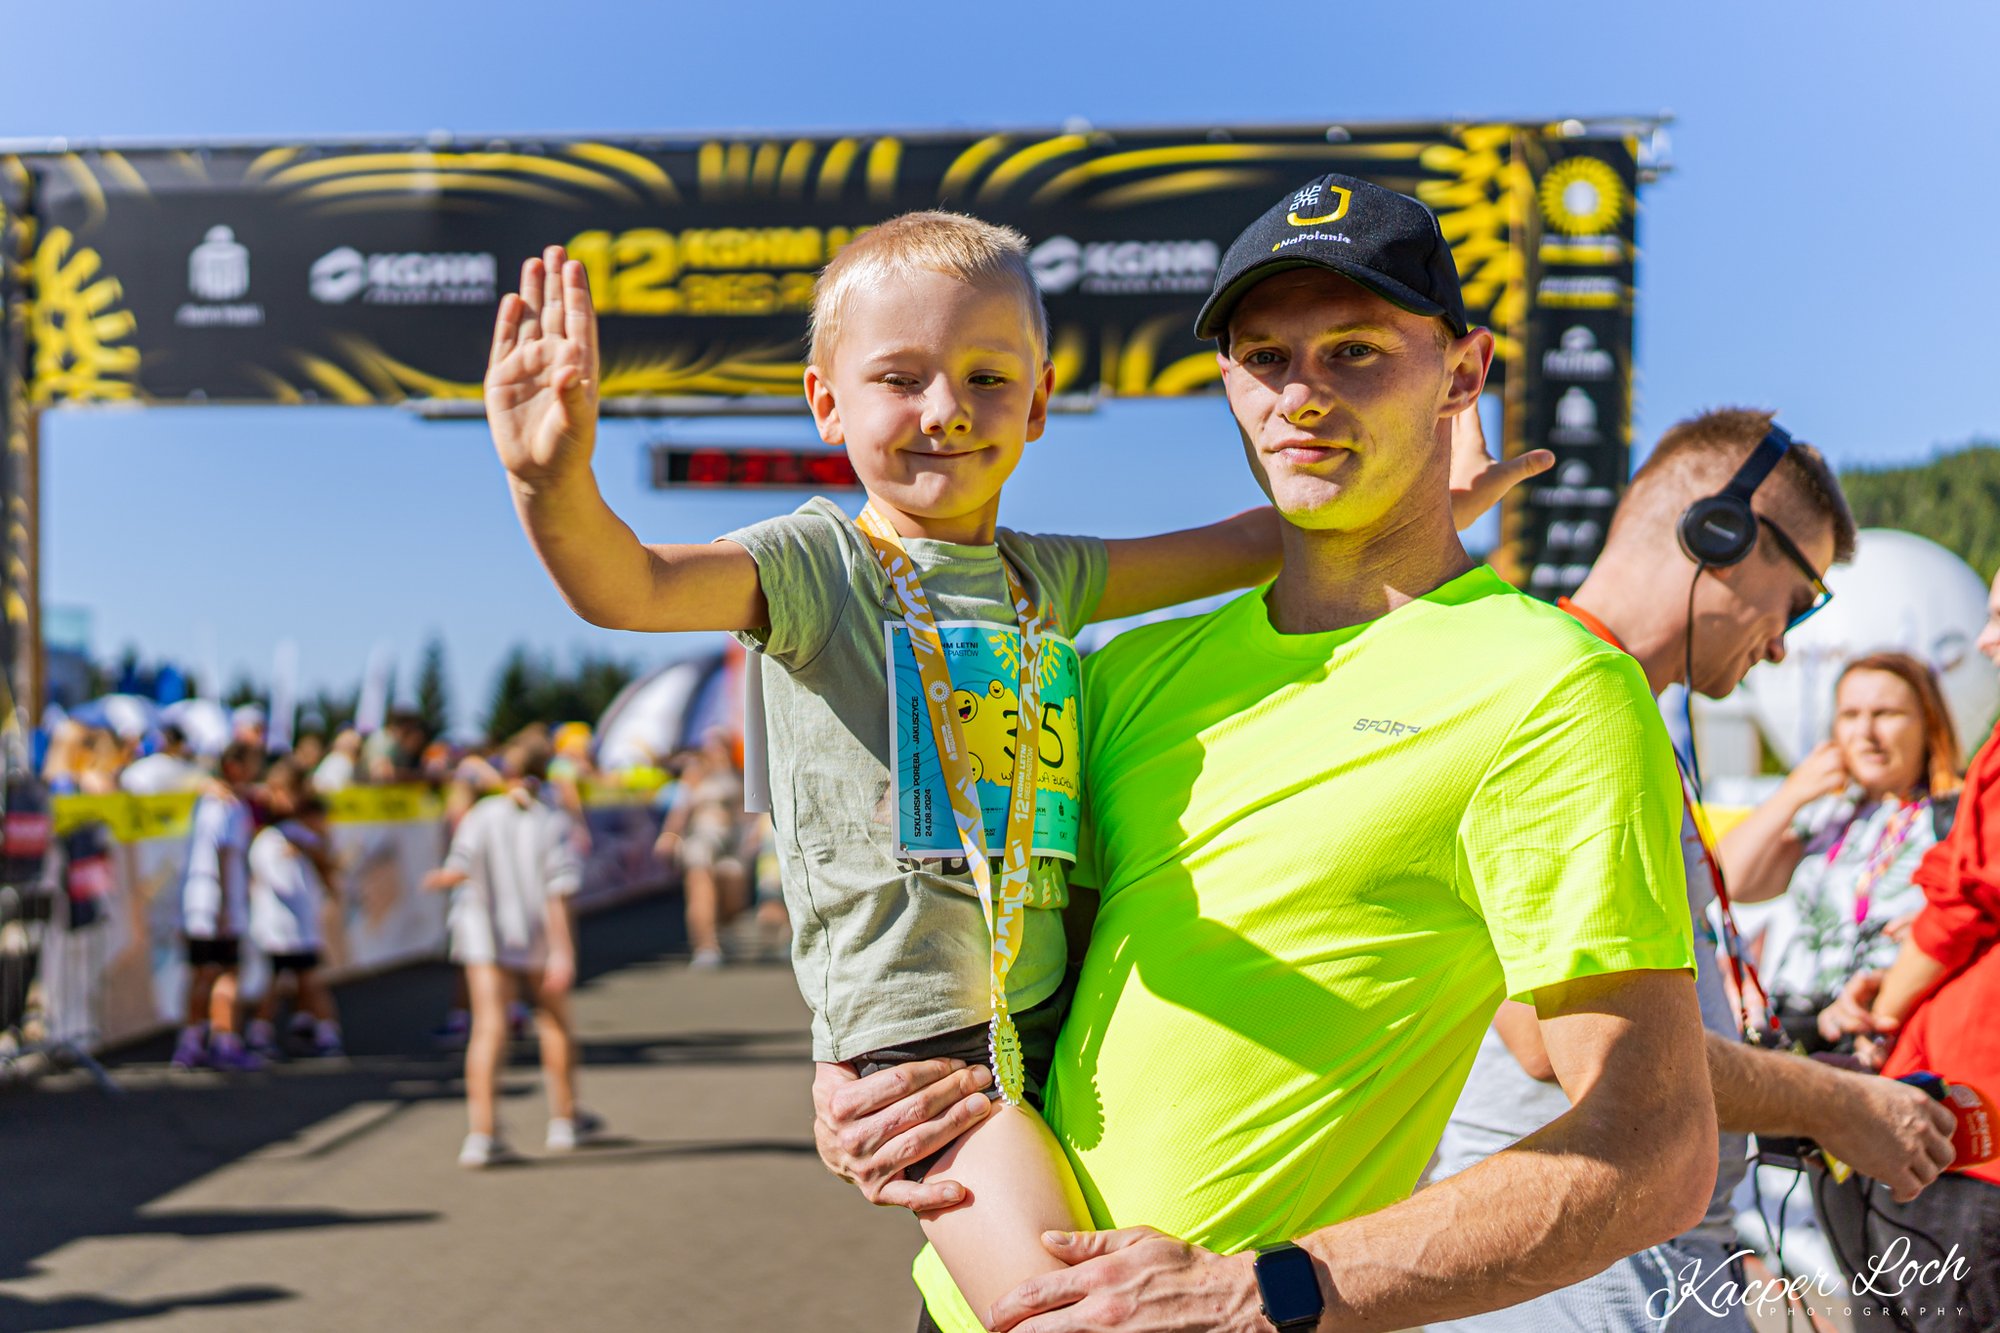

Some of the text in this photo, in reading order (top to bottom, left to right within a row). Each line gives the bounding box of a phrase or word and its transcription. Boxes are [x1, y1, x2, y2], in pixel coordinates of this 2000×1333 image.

[1084, 240, 1219, 273] KGHM
[1271, 230, 1352, 252] #NaPolanie
[366, 252, 497, 287] KGHM
[566, 227, 678, 315] 12
[1017, 771, 1025, 798] KGHM
[913, 788, 921, 837] SZKLARSKA
[1015, 799, 1030, 823] 12
